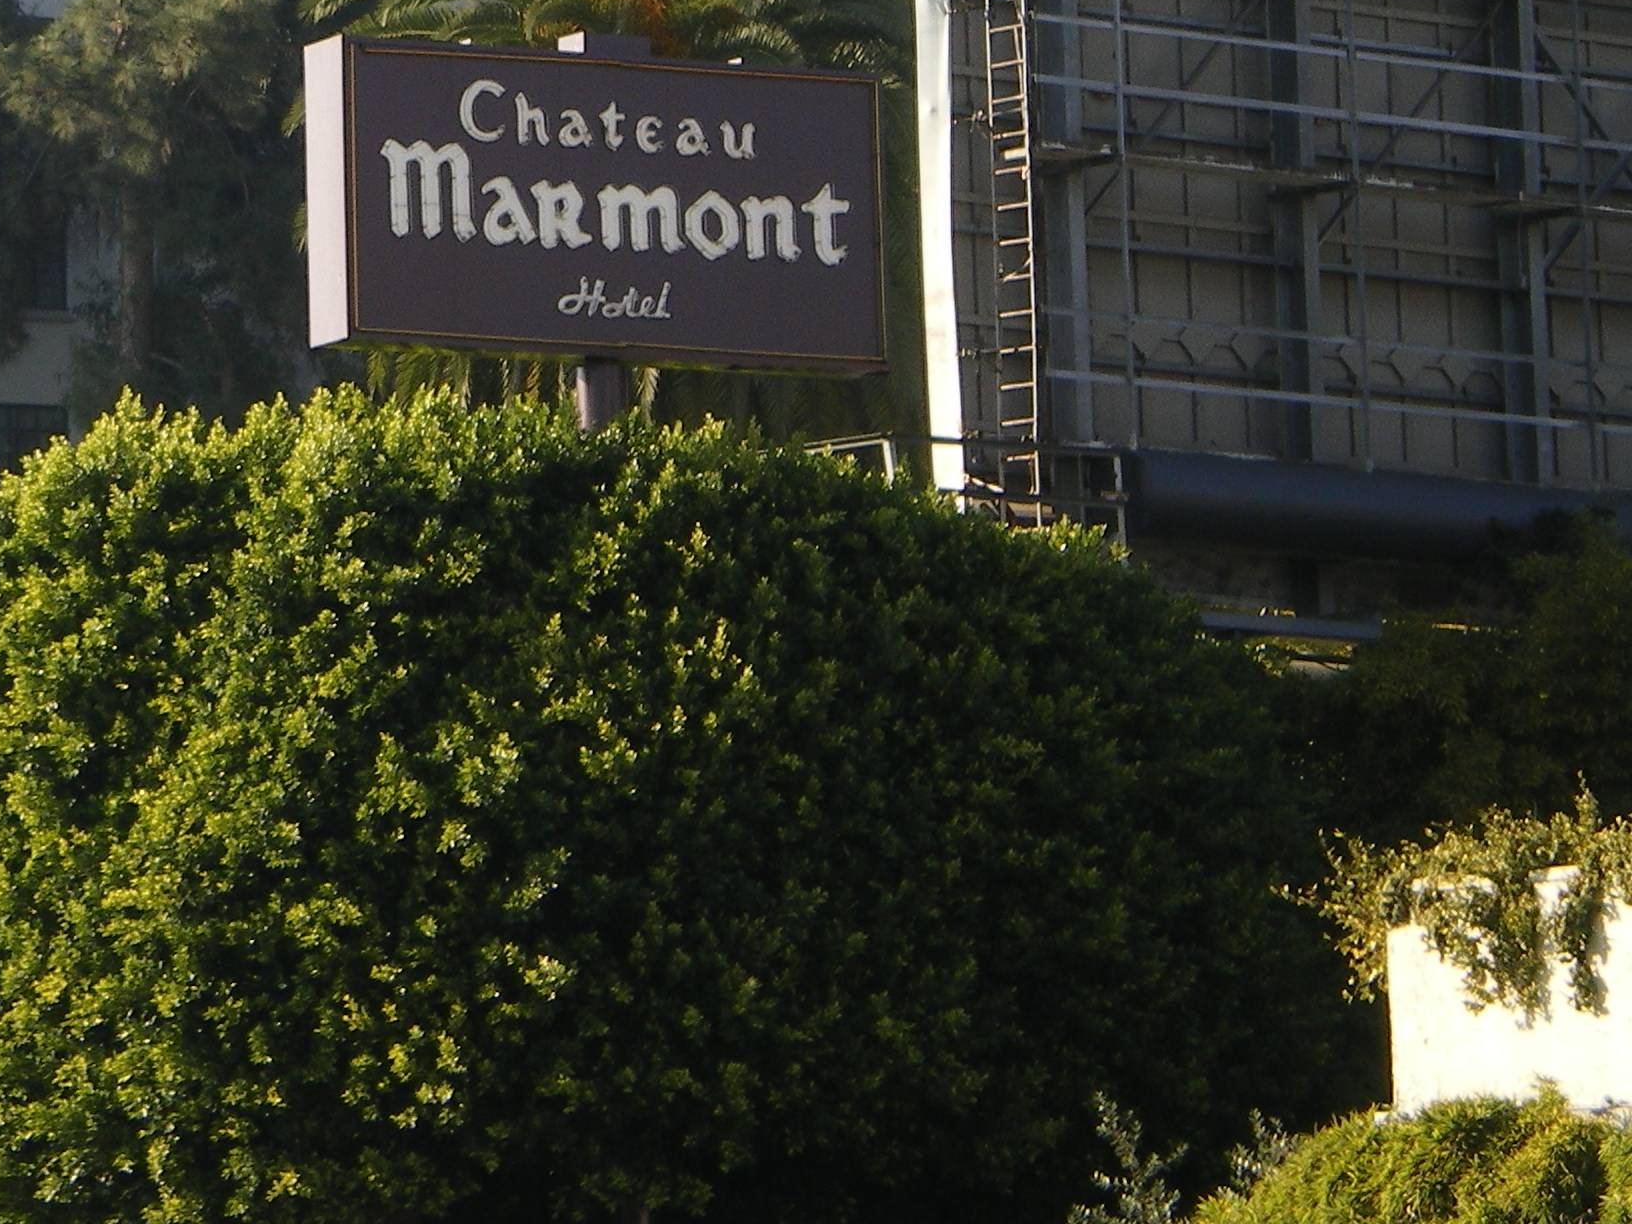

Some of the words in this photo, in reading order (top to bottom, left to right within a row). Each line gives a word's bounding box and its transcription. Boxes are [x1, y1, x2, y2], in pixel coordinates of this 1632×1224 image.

[460, 79, 757, 161] Chateau
[379, 137, 851, 267] Marmont
[556, 275, 672, 320] Hotel
